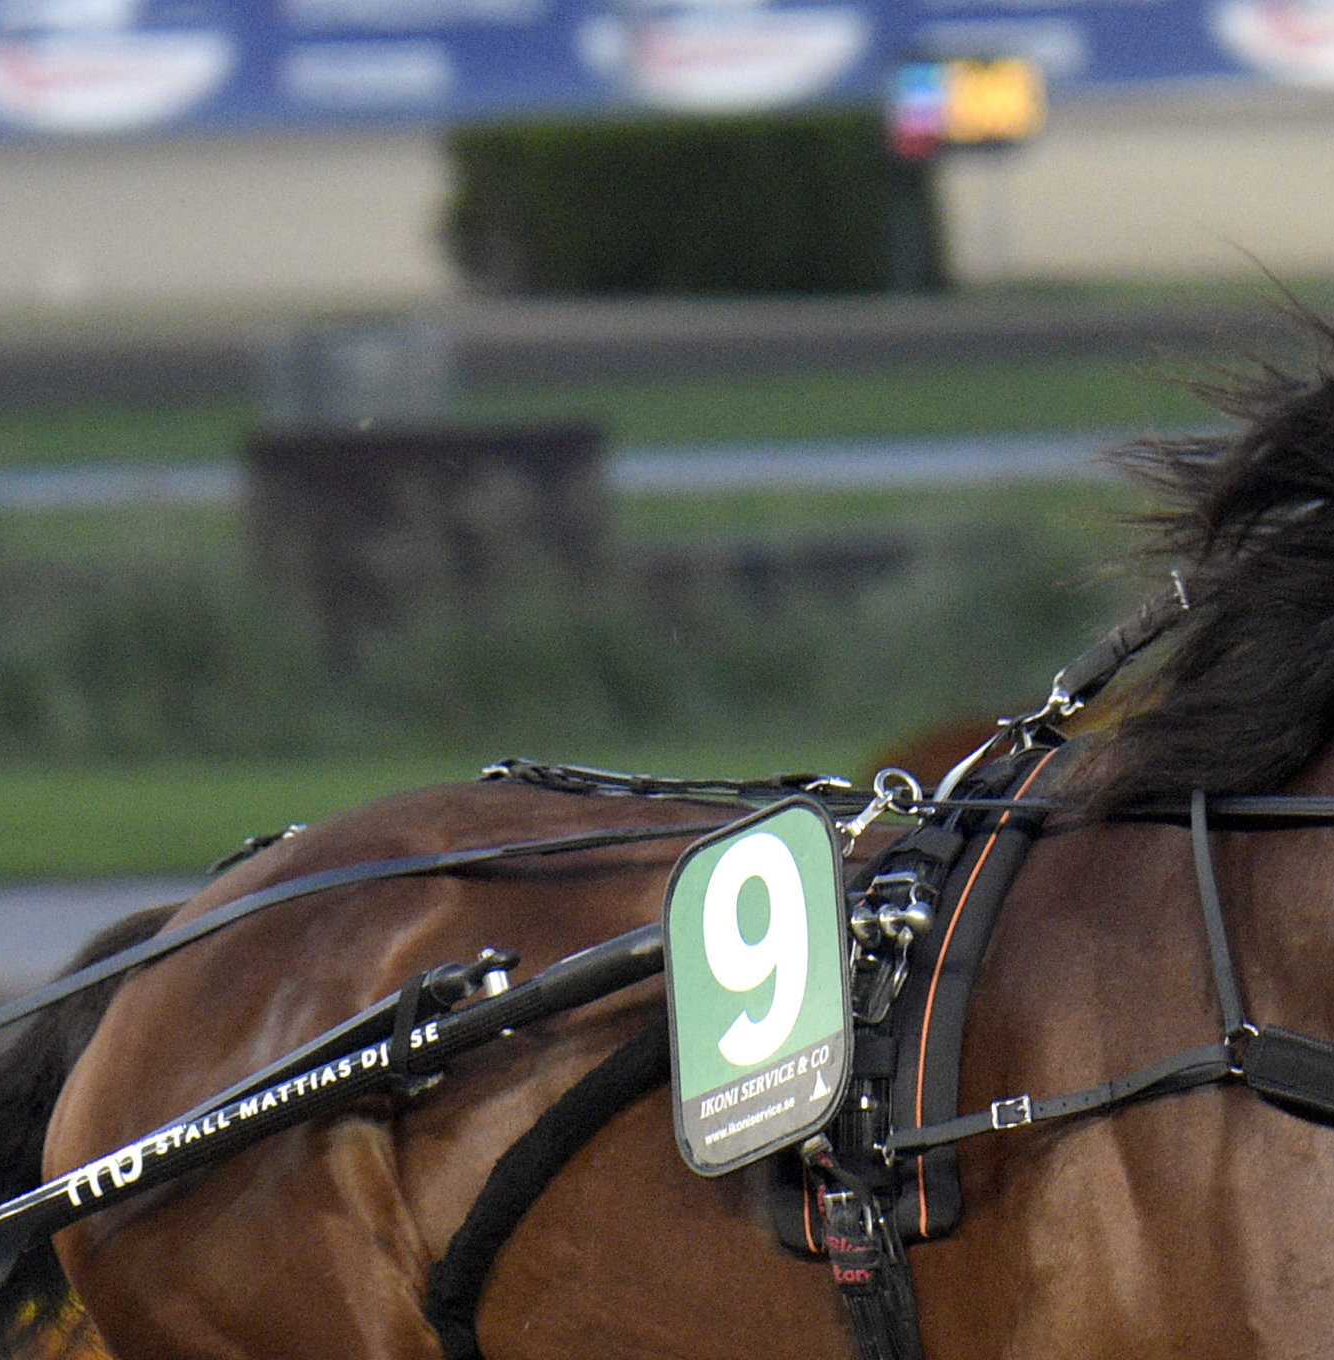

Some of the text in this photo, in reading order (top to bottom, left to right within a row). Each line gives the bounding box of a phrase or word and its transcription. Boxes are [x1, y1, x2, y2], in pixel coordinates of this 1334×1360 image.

[703, 832, 809, 1066] 9
[155, 1112, 230, 1154] STALL
[239, 1058, 352, 1119] MATTIAS
[361, 1022, 439, 1070] DJSE
[700, 1044, 829, 1119] IKONI SERVICE & CO
[705, 1097, 795, 1145] www.ikoniservice.se
